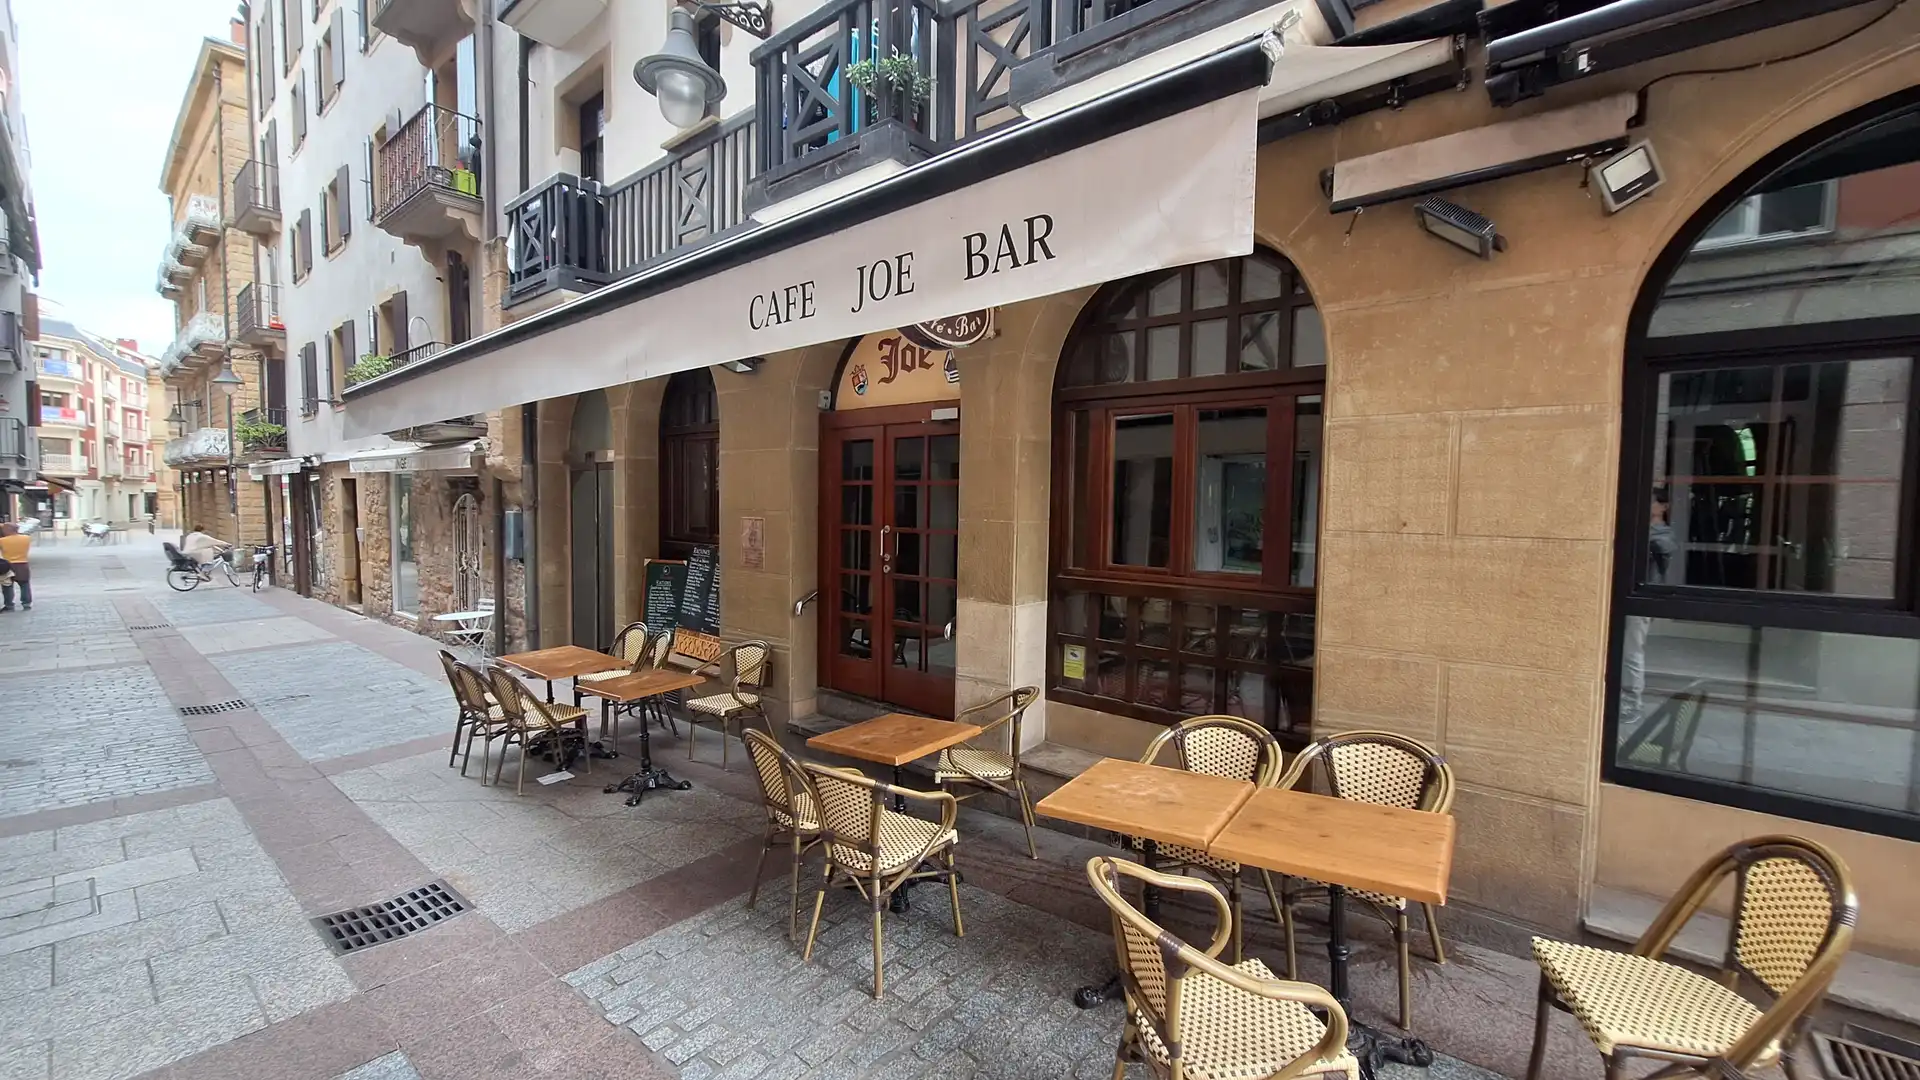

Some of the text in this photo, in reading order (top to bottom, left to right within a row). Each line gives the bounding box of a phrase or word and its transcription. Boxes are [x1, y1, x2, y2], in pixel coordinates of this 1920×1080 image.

[749, 213, 1056, 330] CAFE JOE BAR
[955, 315, 981, 338] Bar
[877, 336, 934, 384] Joe
